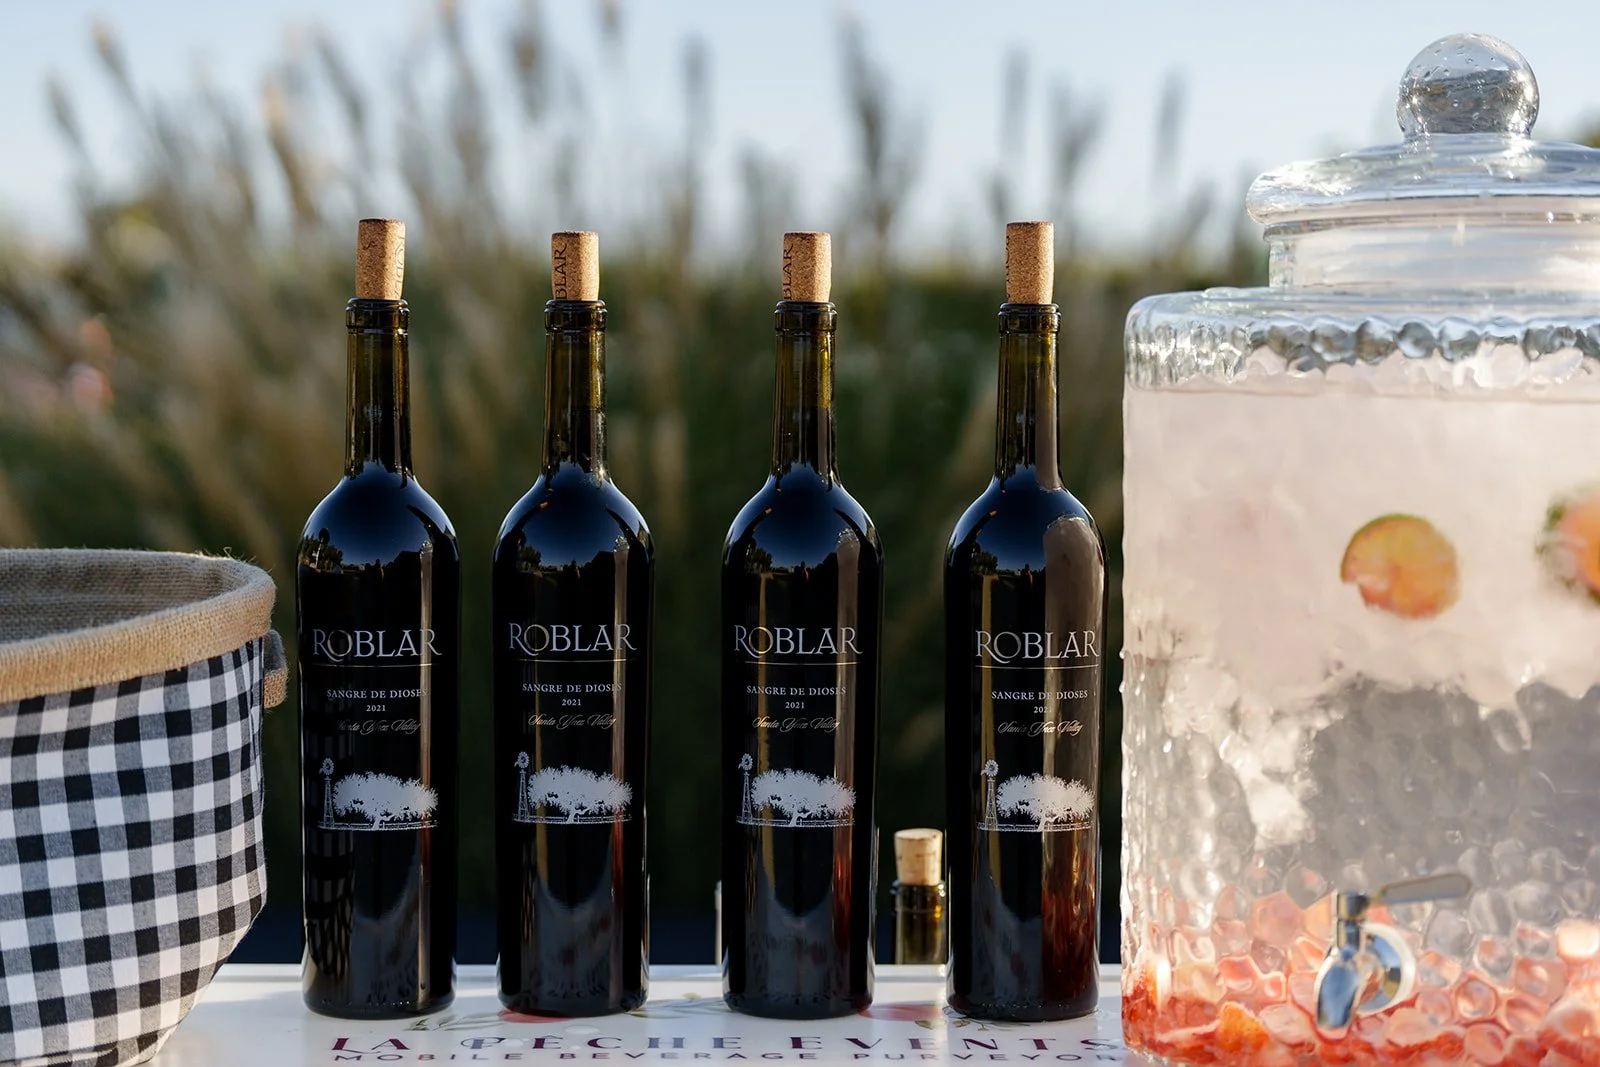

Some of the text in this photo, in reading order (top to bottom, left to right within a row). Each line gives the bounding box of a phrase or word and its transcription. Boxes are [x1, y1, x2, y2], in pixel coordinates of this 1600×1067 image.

[554, 243, 567, 300] BLAR
[312, 628, 442, 662] ROBLAR
[508, 622, 637, 657] ROBLAR
[734, 624, 863, 659] ROBLAR
[975, 630, 1099, 664] ROBLAR
[326, 688, 428, 699] SANGRE DE DIOSES
[522, 683, 622, 693] SANGRE DE DIOSES
[746, 685, 846, 696] SANGRE DE DIOSES
[991, 689, 1088, 700] SANGRE DE DIOSES
[366, 704, 386, 712] 2021
[561, 698, 582, 706] 2021
[785, 701, 805, 709] 2021
[587, 713, 616, 729] Valley
[810, 716, 840, 733] Valley
[331, 1036, 410, 1054] LA
[790, 1036, 1118, 1051] EVENTS
[334, 1053, 523, 1061] MOBILE
[559, 1052, 818, 1060] BEVERAGE
